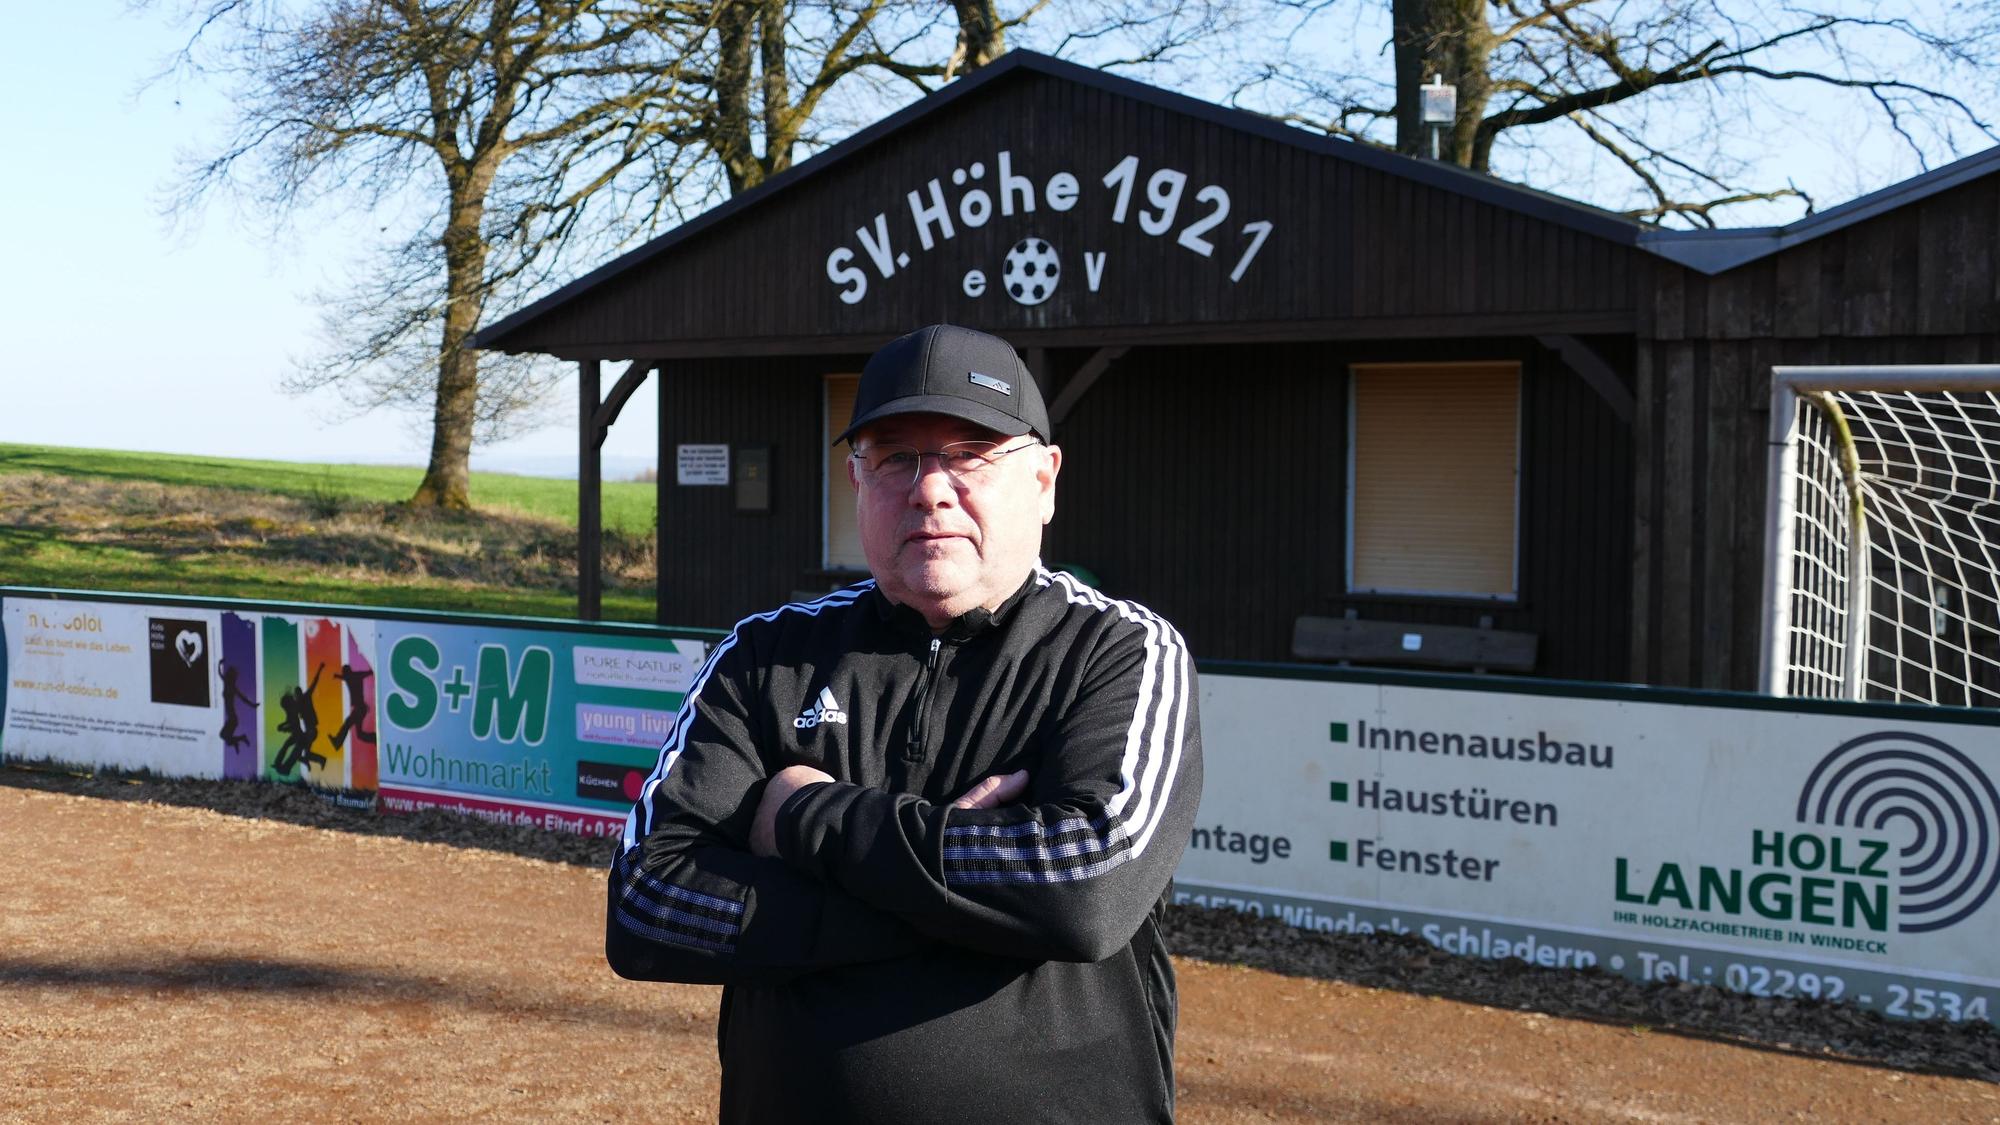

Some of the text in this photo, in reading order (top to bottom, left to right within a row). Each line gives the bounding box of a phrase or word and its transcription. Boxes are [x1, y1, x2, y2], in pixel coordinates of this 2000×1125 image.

[826, 150, 1274, 305] SV. Höhe 1921
[962, 269, 987, 298] e
[584, 656, 683, 674] PURE NATUR
[385, 634, 553, 747] S+M
[583, 711, 635, 736] young
[793, 707, 847, 729] addas
[1358, 719, 1613, 770] Innenausbau
[386, 743, 553, 795] Wohnmarkt
[1357, 779, 1558, 827] Haustüren
[1356, 838, 1500, 882] Fenster
[1753, 829, 1889, 878] HOLZ
[1615, 857, 1888, 932] LANGEN
[1614, 911, 1888, 955] IHR HOLZFACHBETRIEB IN WINDECK
